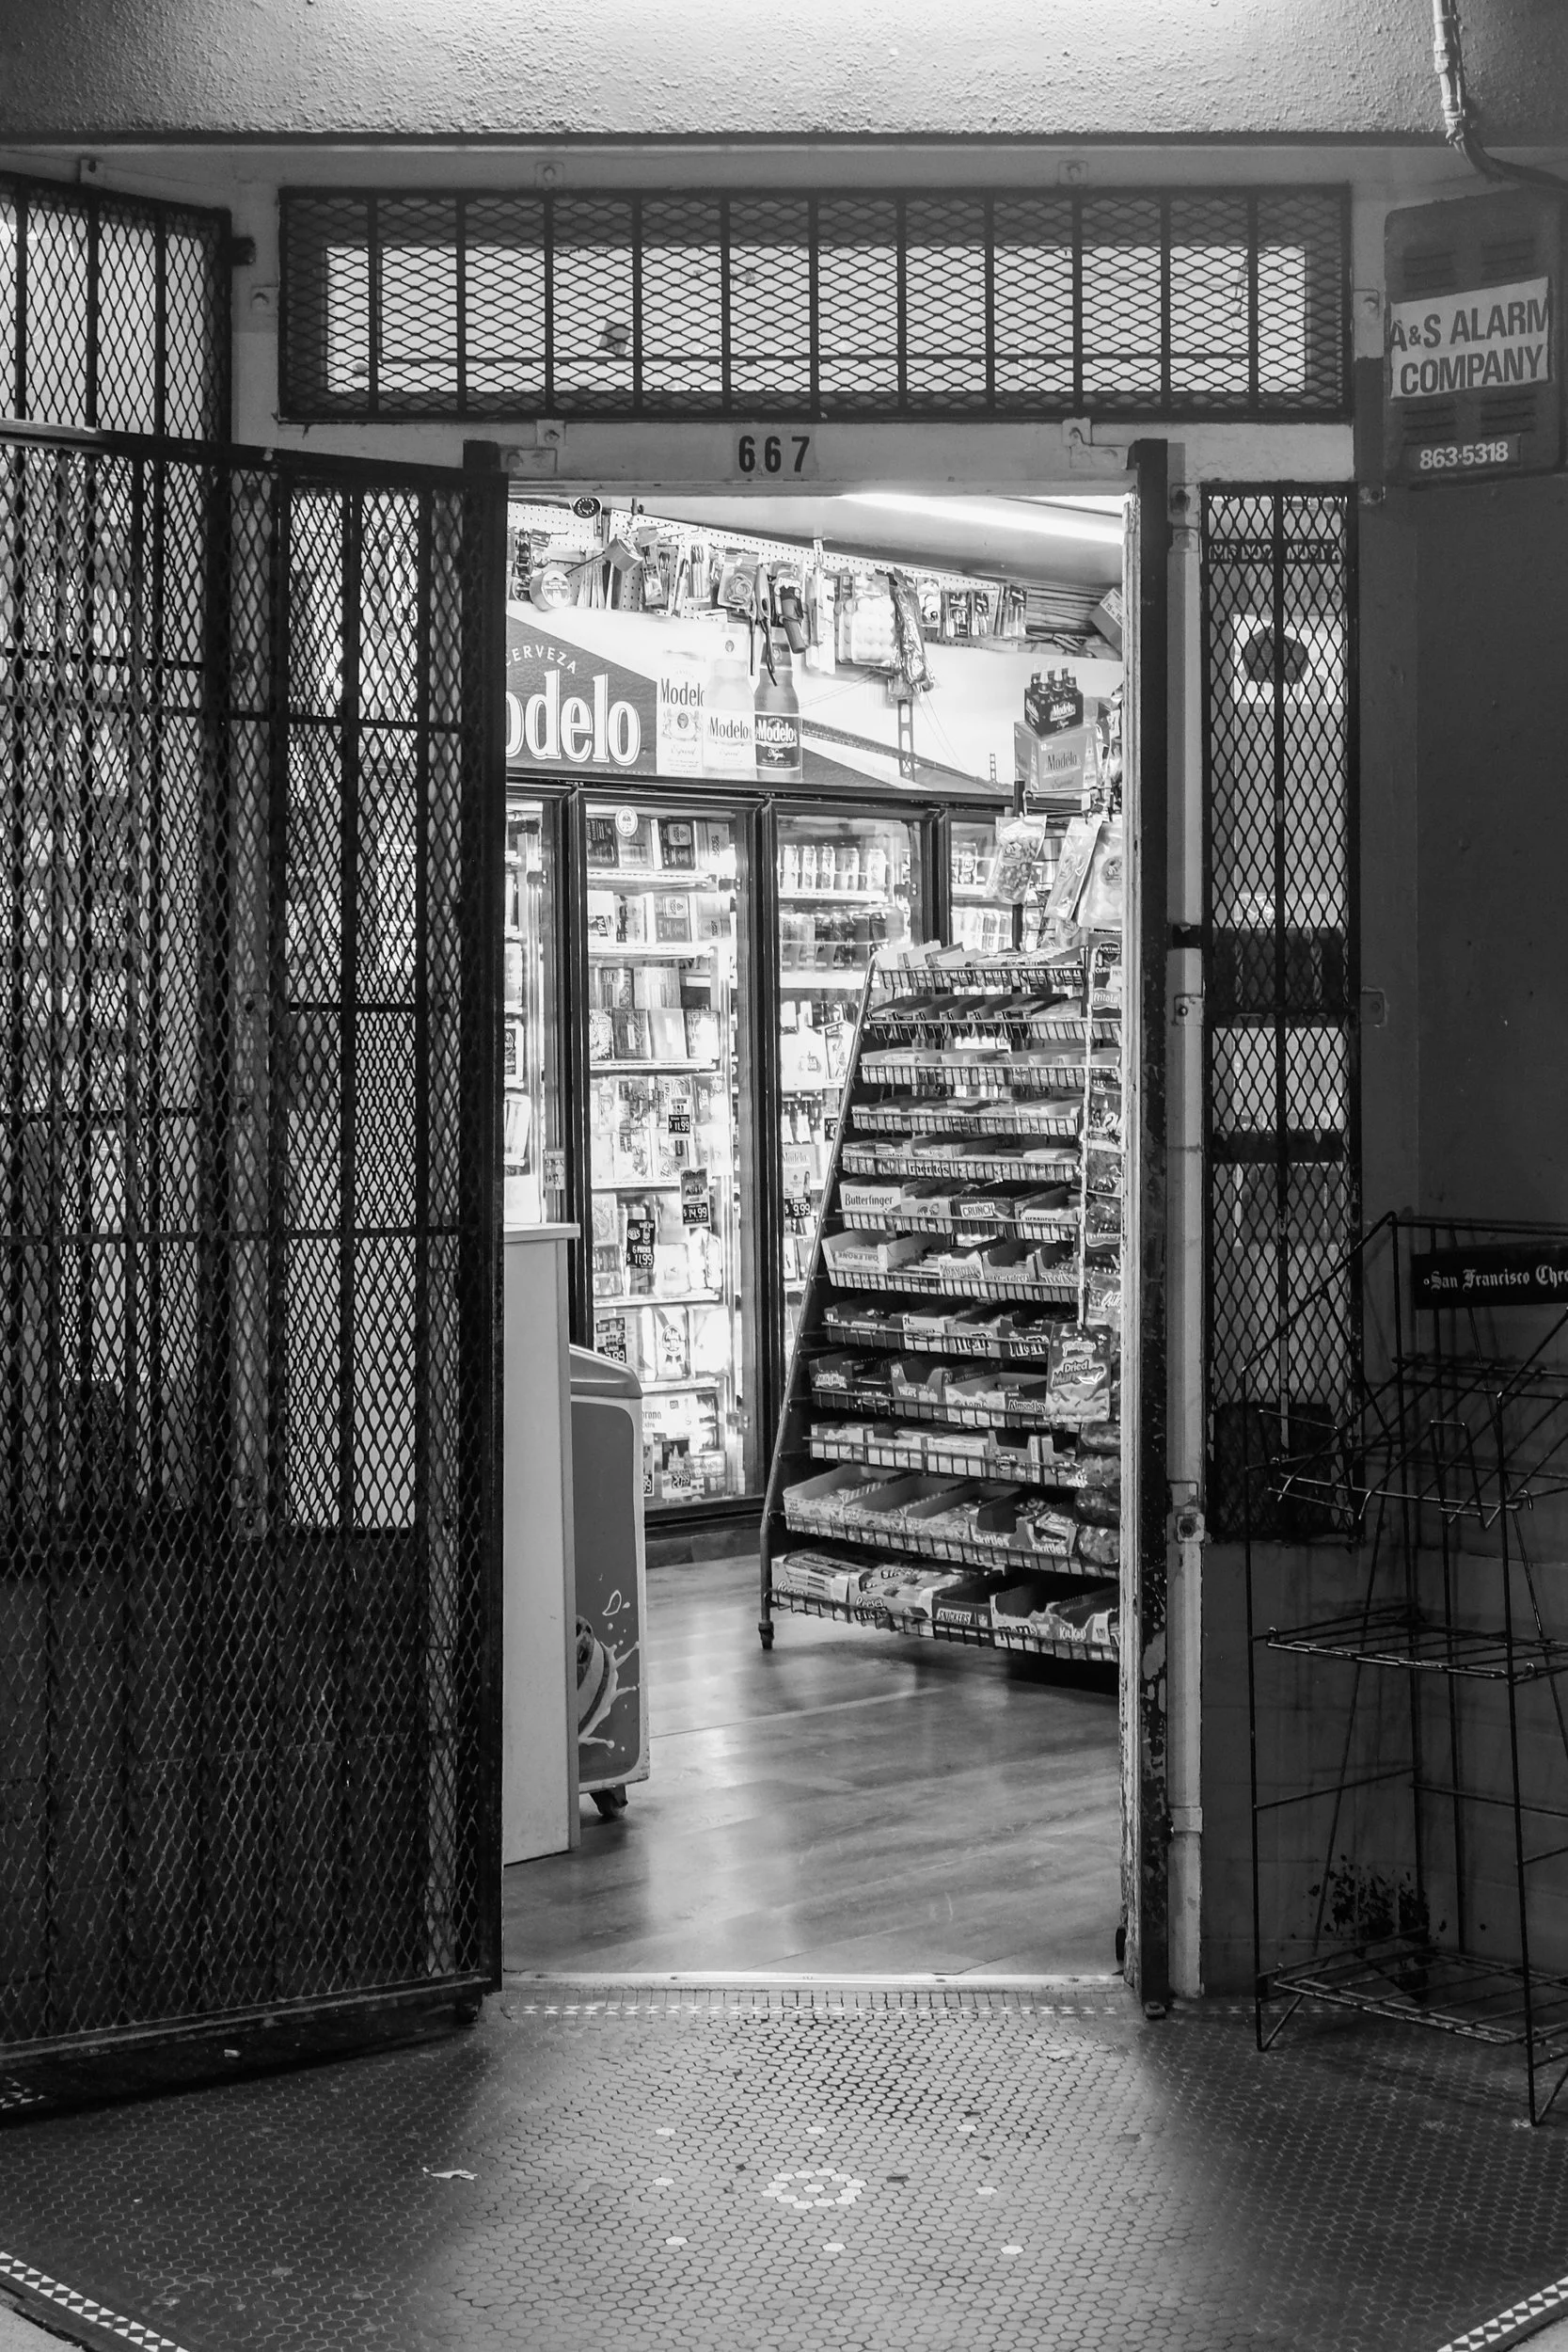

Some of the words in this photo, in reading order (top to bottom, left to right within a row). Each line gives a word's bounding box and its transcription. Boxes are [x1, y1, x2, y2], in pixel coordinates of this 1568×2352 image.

[1390, 312, 1442, 352] A&S
[1449, 297, 1549, 345] ALARM
[1400, 343, 1544, 396] COMPANY
[738, 435, 810, 473] 667
[506, 644, 578, 675] ERVEZA
[709, 716, 750, 739] Modelo
[756, 719, 795, 743] Modelo
[1047, 751, 1078, 771] Modelo
[910, 1164, 949, 1175] mentos
[844, 1192, 895, 1208] Butterfinger
[689, 1207, 707, 1218] 14.99
[793, 1203, 811, 1216] 9.99
[961, 1203, 994, 1218] CRUNCH
[837, 1252, 879, 1263] OBLERONE
[1041, 1271, 1075, 1285] Twix
[1431, 1270, 1458, 1290] San
[1462, 1267, 1530, 1292] Francisco
[1064, 1359, 1089, 1374] Dried
[1008, 1399, 1032, 1411] Almond
[938, 1609, 971, 1624] SNICKERS
